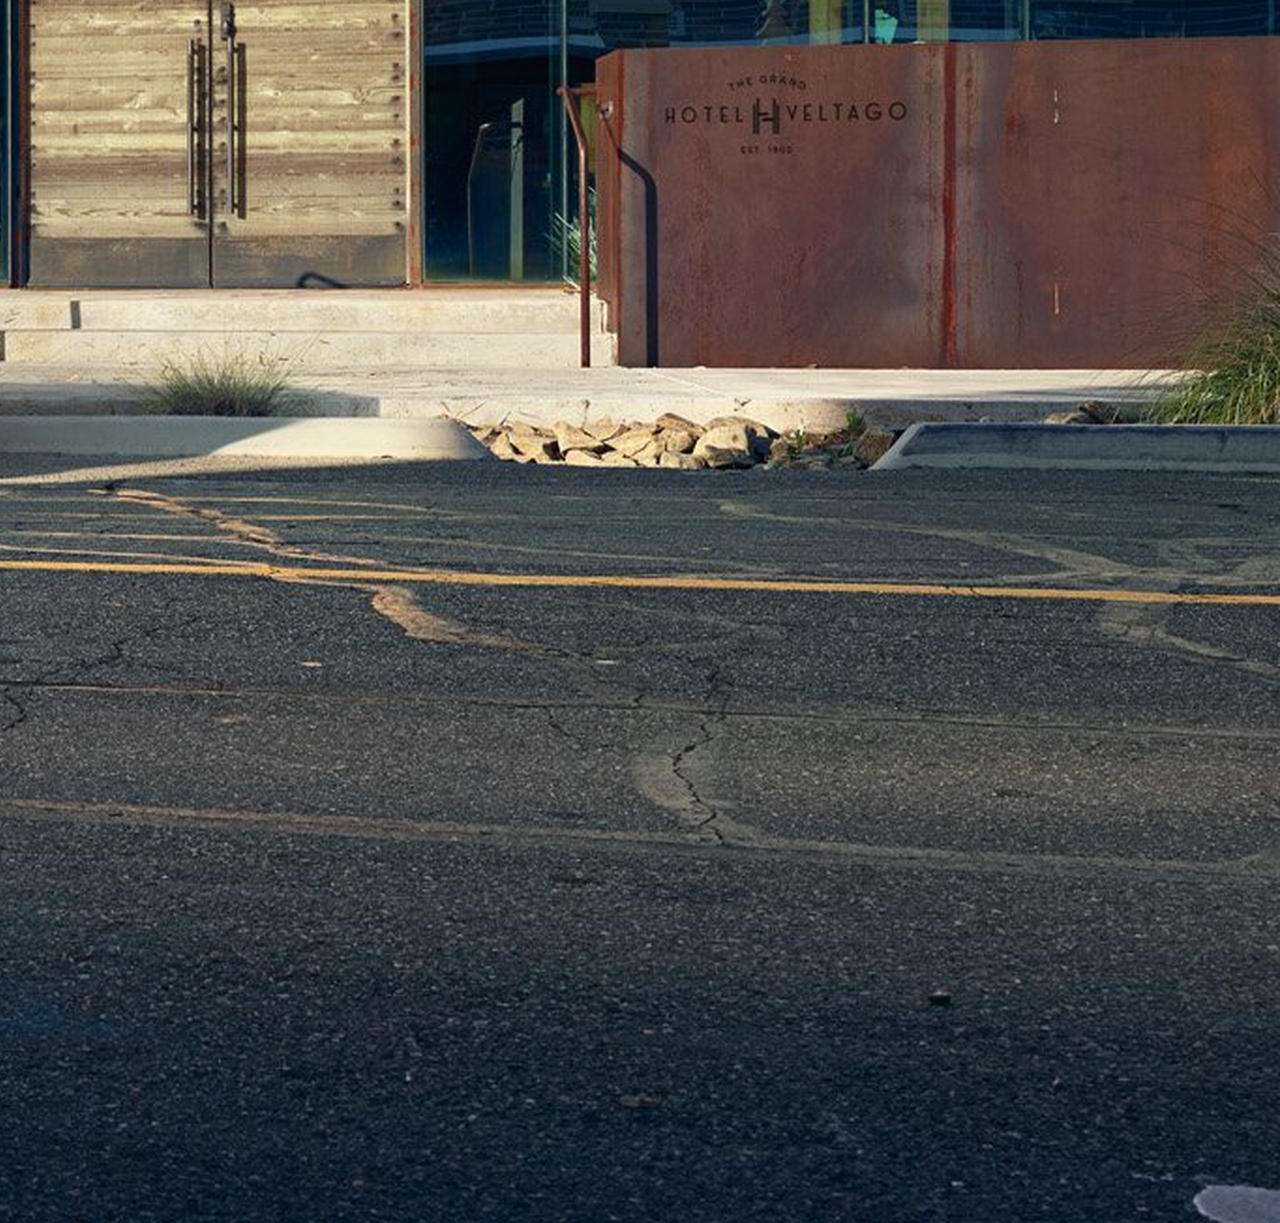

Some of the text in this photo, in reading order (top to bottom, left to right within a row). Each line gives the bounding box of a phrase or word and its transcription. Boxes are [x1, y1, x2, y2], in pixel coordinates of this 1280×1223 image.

[727, 73, 808, 92] THE GRAND
[664, 105, 744, 124] HOTEL
[786, 101, 909, 122] VELTAGO
